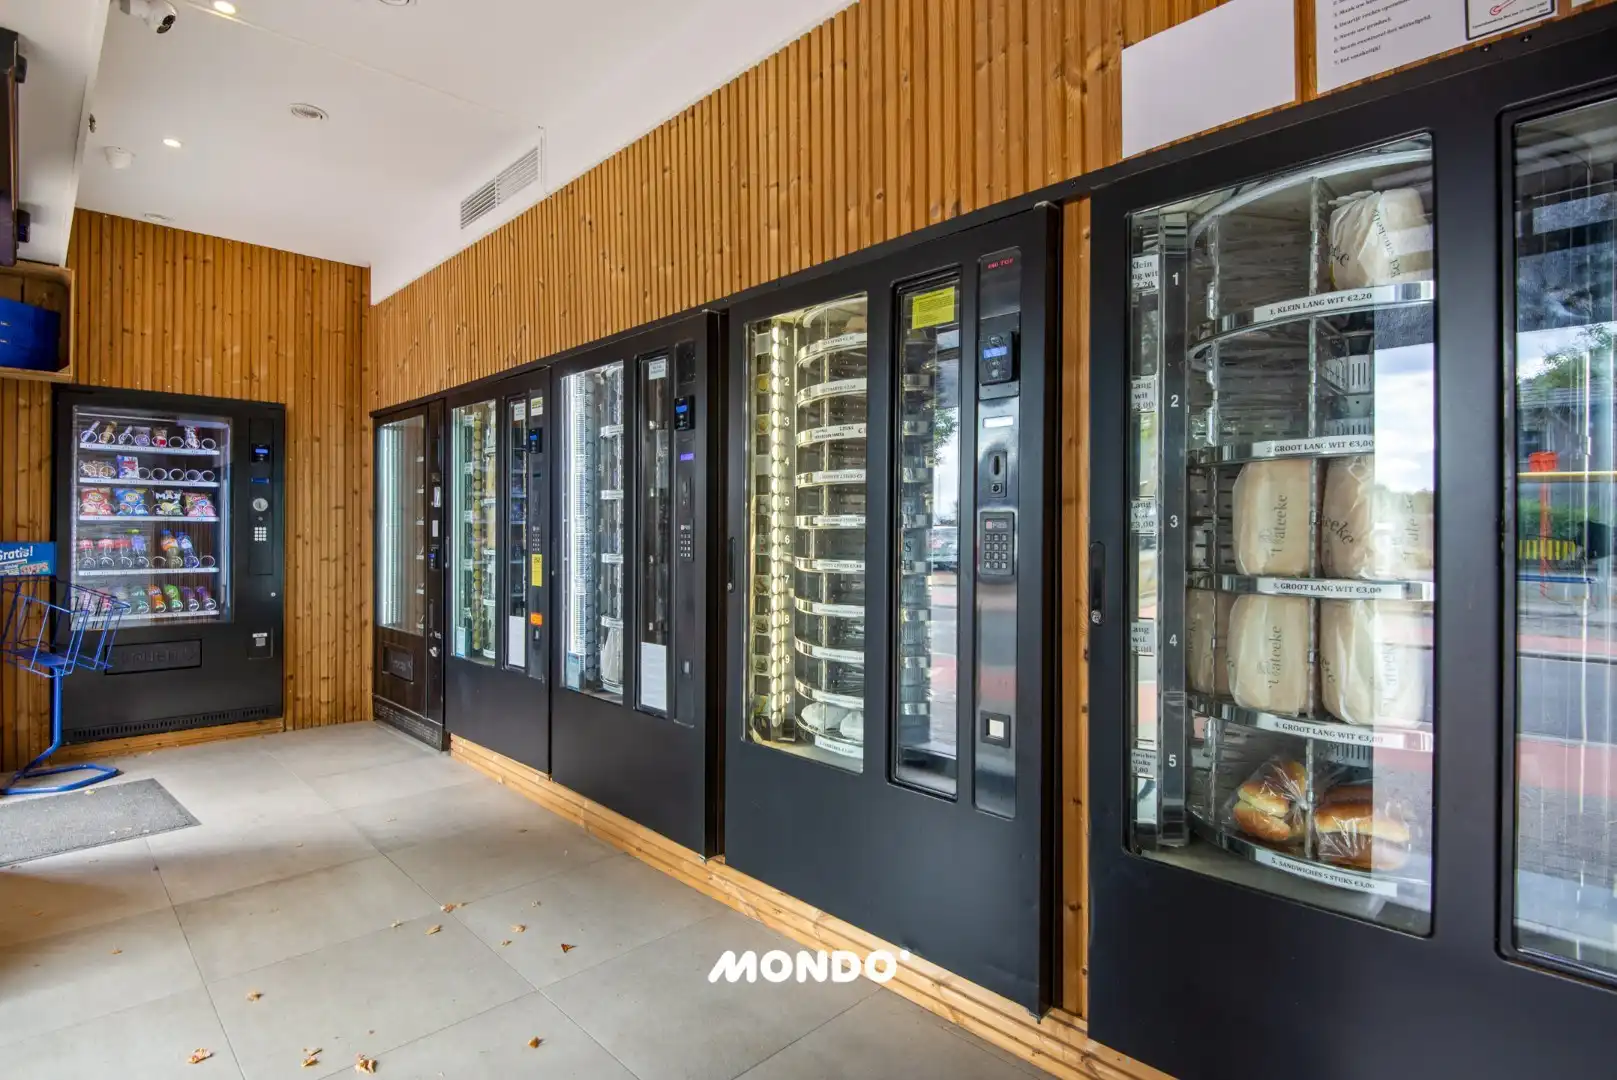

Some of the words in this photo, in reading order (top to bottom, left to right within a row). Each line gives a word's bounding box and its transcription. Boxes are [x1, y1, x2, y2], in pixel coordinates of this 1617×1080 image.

[1172, 272, 1179, 286] 1
[1278, 304, 1300, 314] KLEIN
[1302, 298, 1325, 309] LANG
[1327, 296, 1345, 304] WIT
[1347, 292, 1372, 302] €2,20
[785, 336, 789, 346] 1
[784, 377, 790, 386] 2
[1171, 394, 1179, 408] 2
[784, 417, 790, 426] 3
[1274, 444, 1302, 452] GROOT
[784, 457, 790, 466] 4
[784, 497, 790, 506] 5
[1170, 514, 1178, 528] 3
[785, 535, 790, 544] 6
[785, 574, 790, 584] 7
[1310, 584, 1333, 592] LANG
[785, 614, 790, 624] 8
[1169, 634, 1178, 647] 4
[785, 654, 790, 664] 9
[1282, 723, 1311, 734] GROOT
[1313, 728, 1336, 737] LANG
[1169, 754, 1176, 767] 5
[1272, 857, 1278, 865] 5.
[1279, 860, 1322, 878] SANDWICHES
[1330, 875, 1353, 885] STUKS
